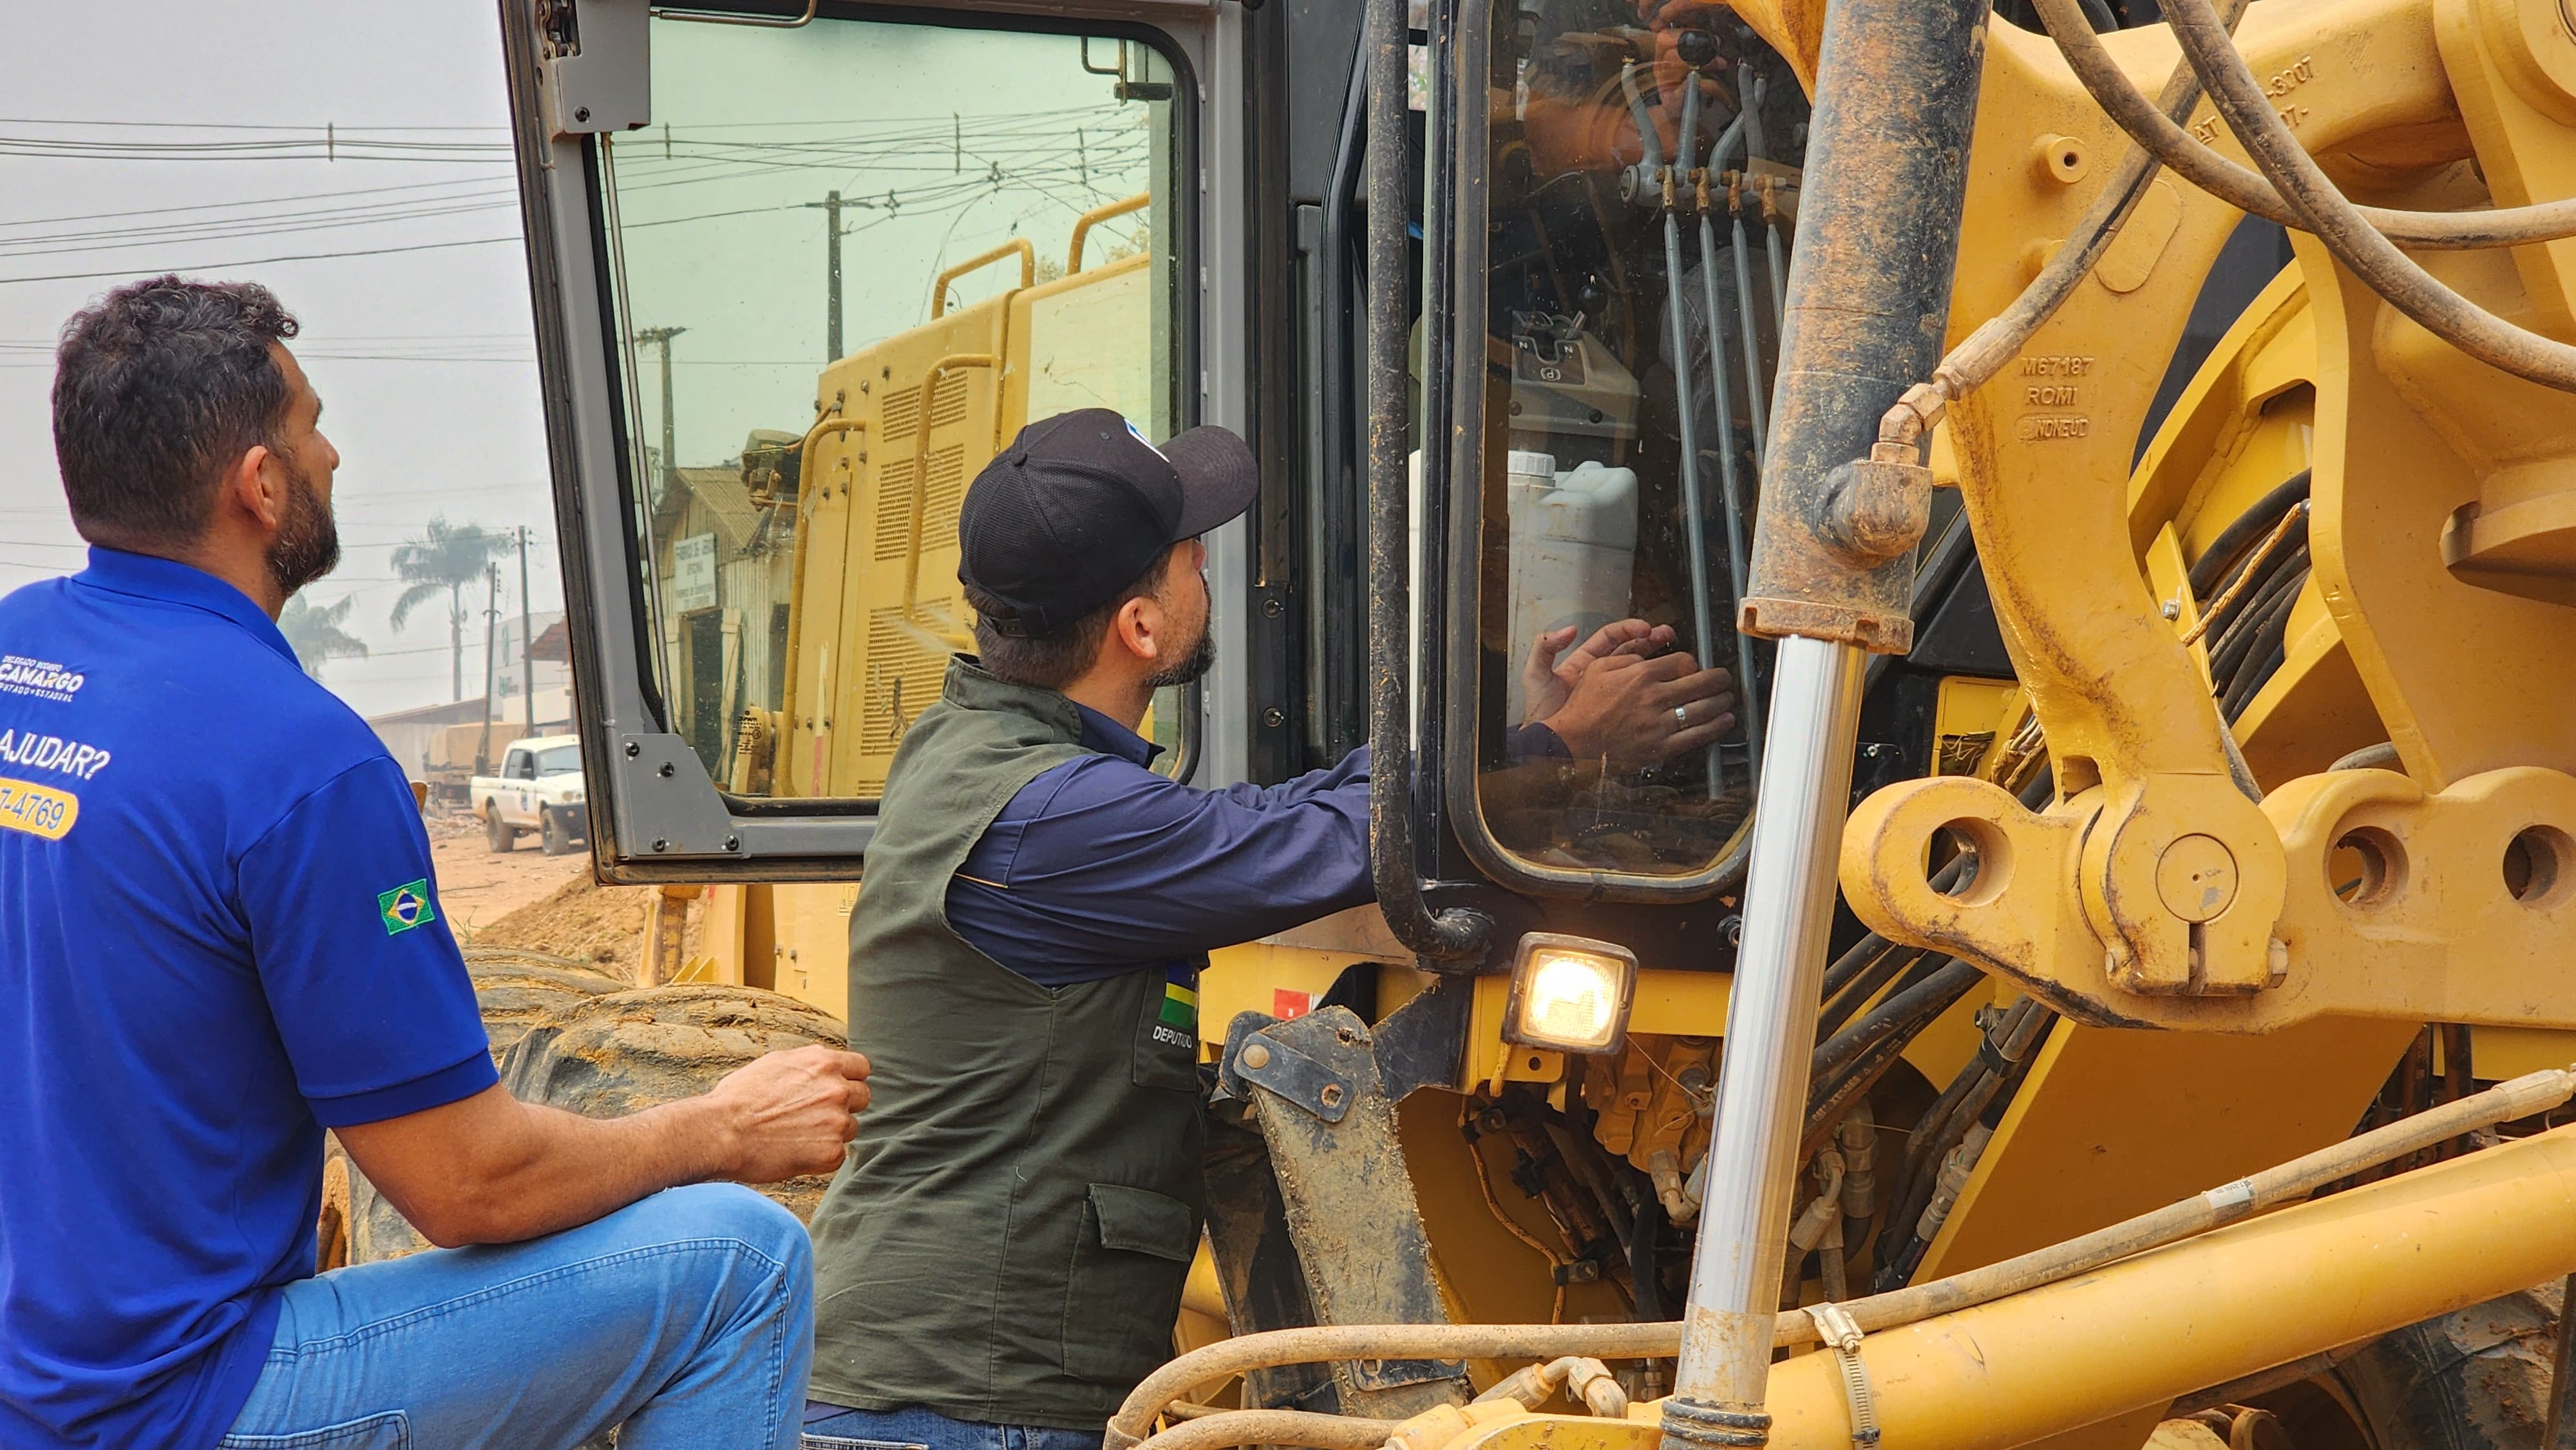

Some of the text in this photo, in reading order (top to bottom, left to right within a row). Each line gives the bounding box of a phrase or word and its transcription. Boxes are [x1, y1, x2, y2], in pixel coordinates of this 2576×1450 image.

[2025, 386, 2078, 407] ROMI
[0, 663, 84, 693] CAMARGO
[0, 728, 111, 780] AJUDAR?
